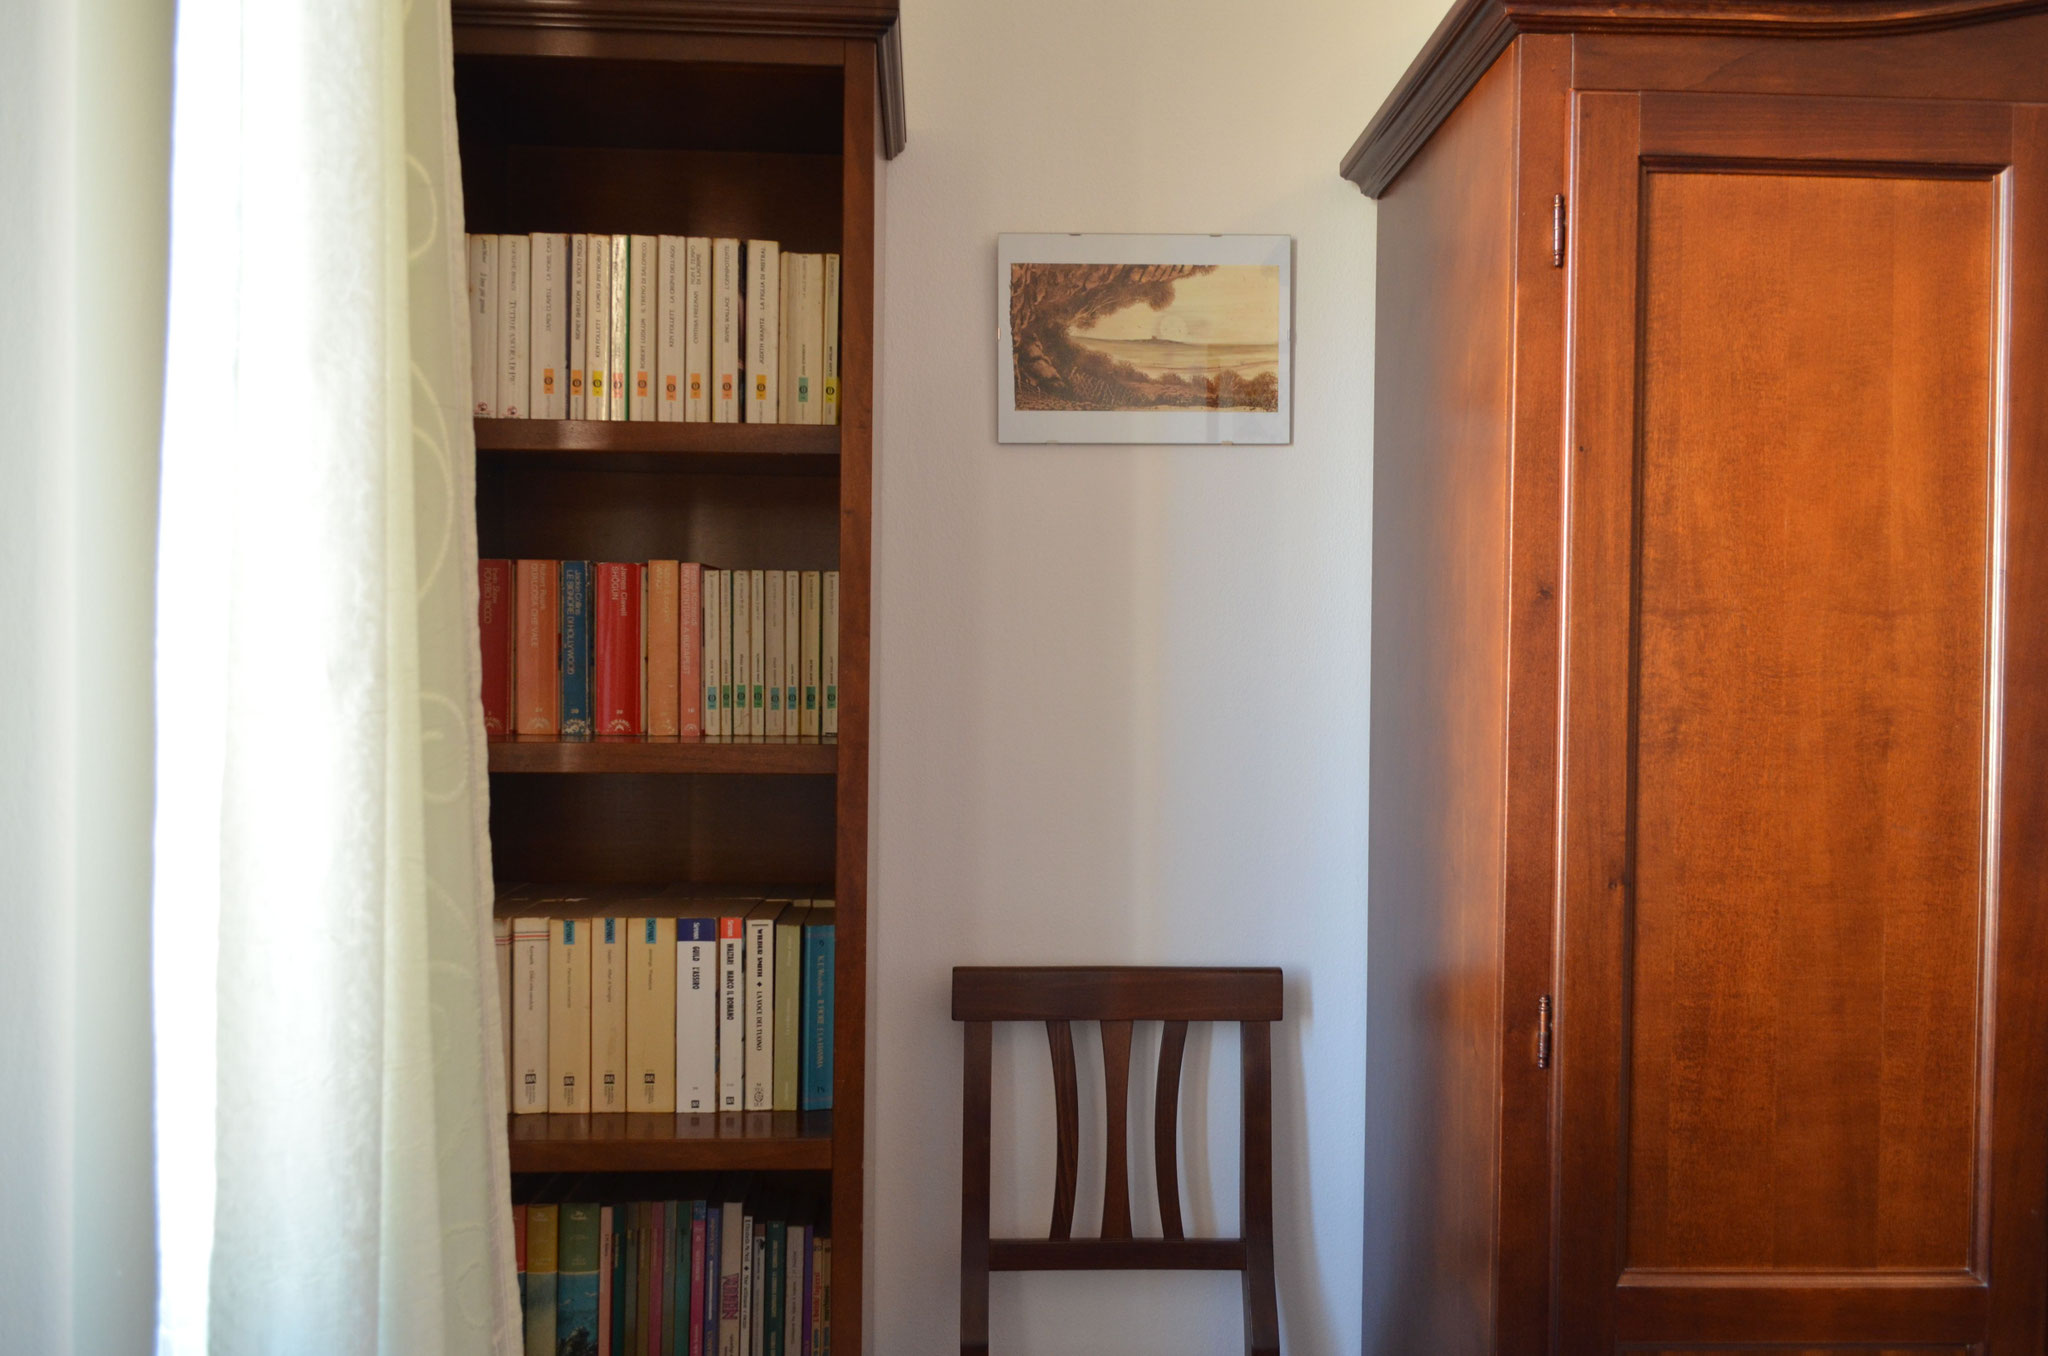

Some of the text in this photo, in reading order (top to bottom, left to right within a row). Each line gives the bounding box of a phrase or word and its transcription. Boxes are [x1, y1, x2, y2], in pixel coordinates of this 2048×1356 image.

[567, 570, 574, 580] LE
[530, 627, 538, 647] VALE
[567, 624, 575, 674] HOLLYWOOD
[692, 946, 700, 962] GUILD
[692, 967, 700, 990] L'ASSIRO
